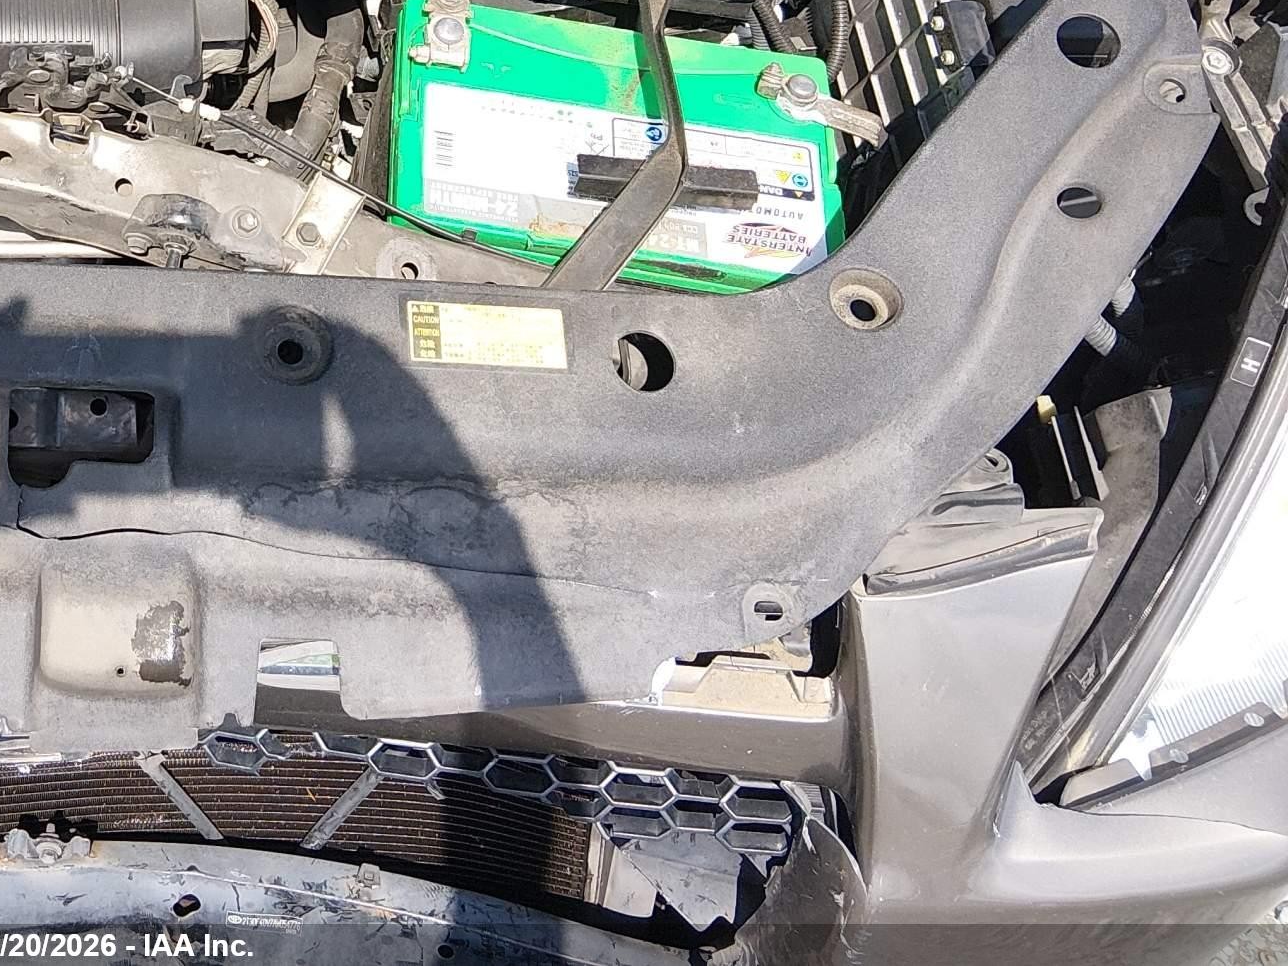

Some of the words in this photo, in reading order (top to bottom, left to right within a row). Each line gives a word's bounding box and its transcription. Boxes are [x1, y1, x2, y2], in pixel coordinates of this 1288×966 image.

[759, 184, 784, 195] DAN
[732, 225, 807, 244] BATTERIES
[726, 234, 812, 257] INTERSTATE
[1241, 357, 1261, 373] H
